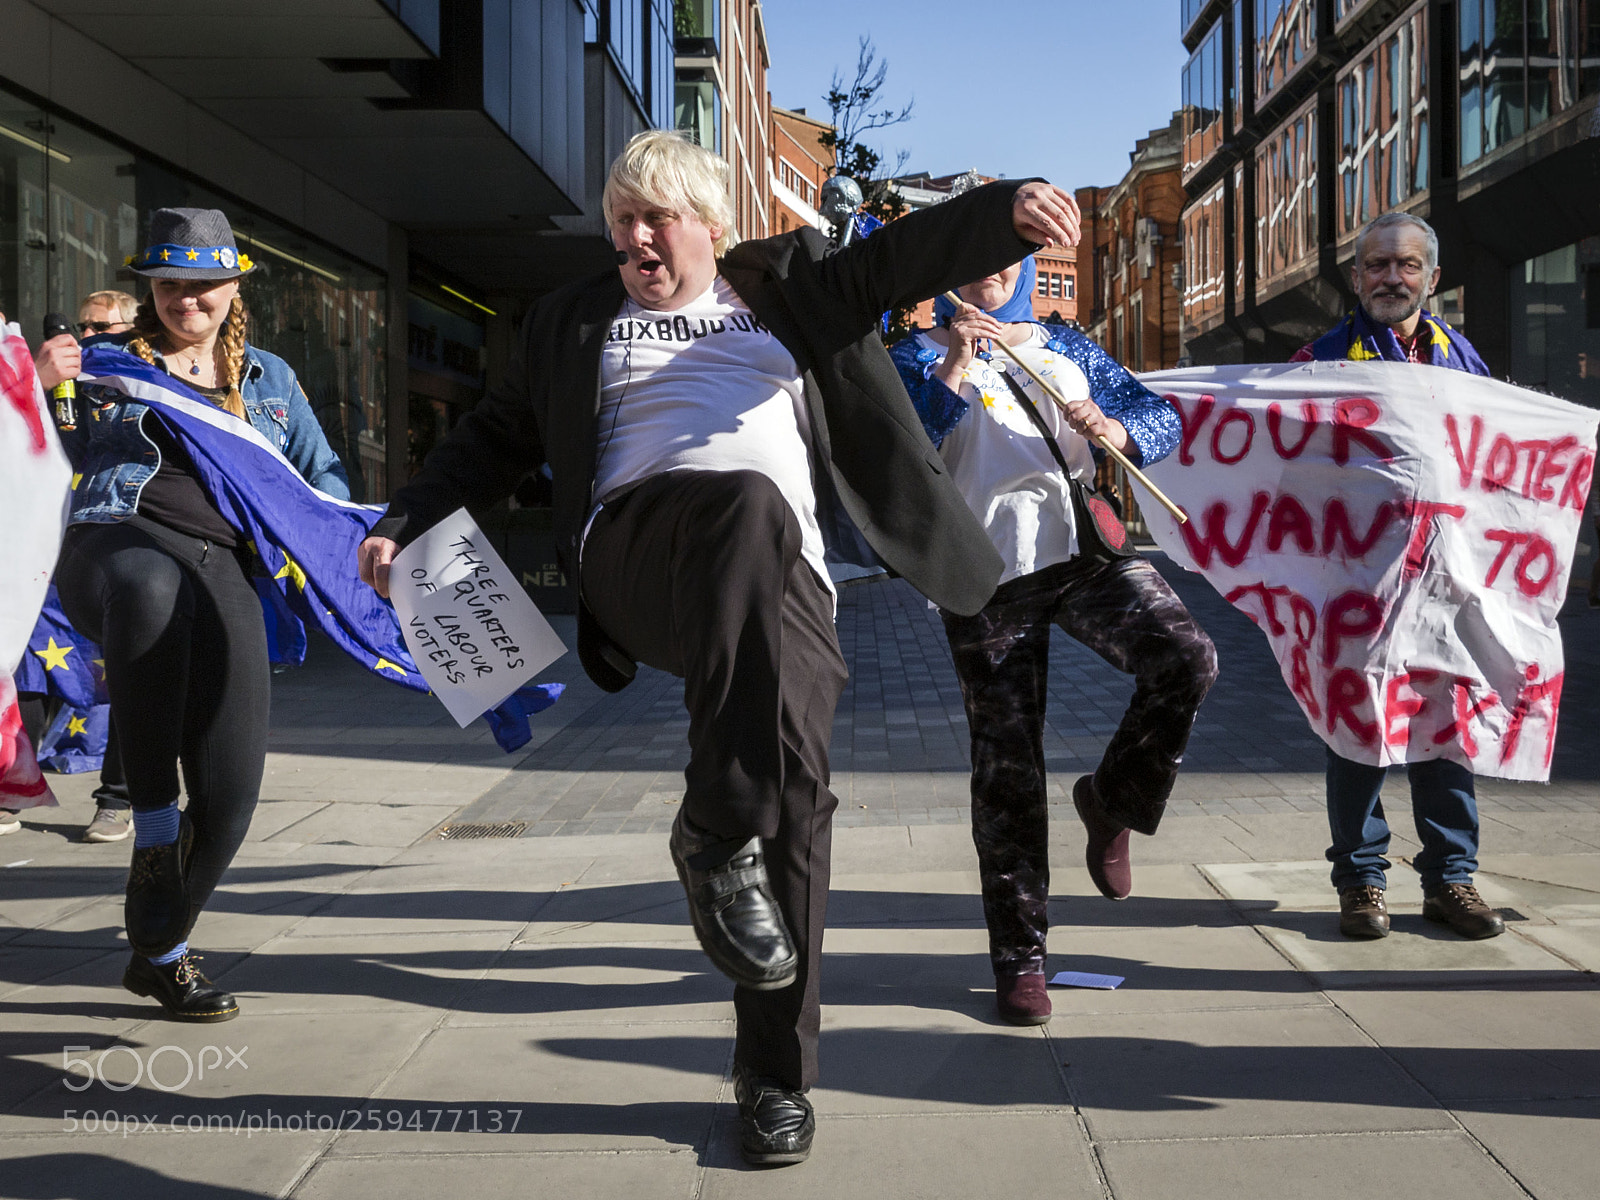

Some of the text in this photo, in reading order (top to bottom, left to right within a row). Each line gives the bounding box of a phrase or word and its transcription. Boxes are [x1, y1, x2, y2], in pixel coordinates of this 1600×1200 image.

[1163, 394, 1395, 467] YOUR
[449, 535, 510, 604] THREE
[1175, 490, 1556, 598] WANT TO
[411, 568, 437, 592] OF
[410, 616, 465, 684] VOTERS
[434, 615, 493, 678] LABOUR
[453, 580, 524, 669] QUARTERS
